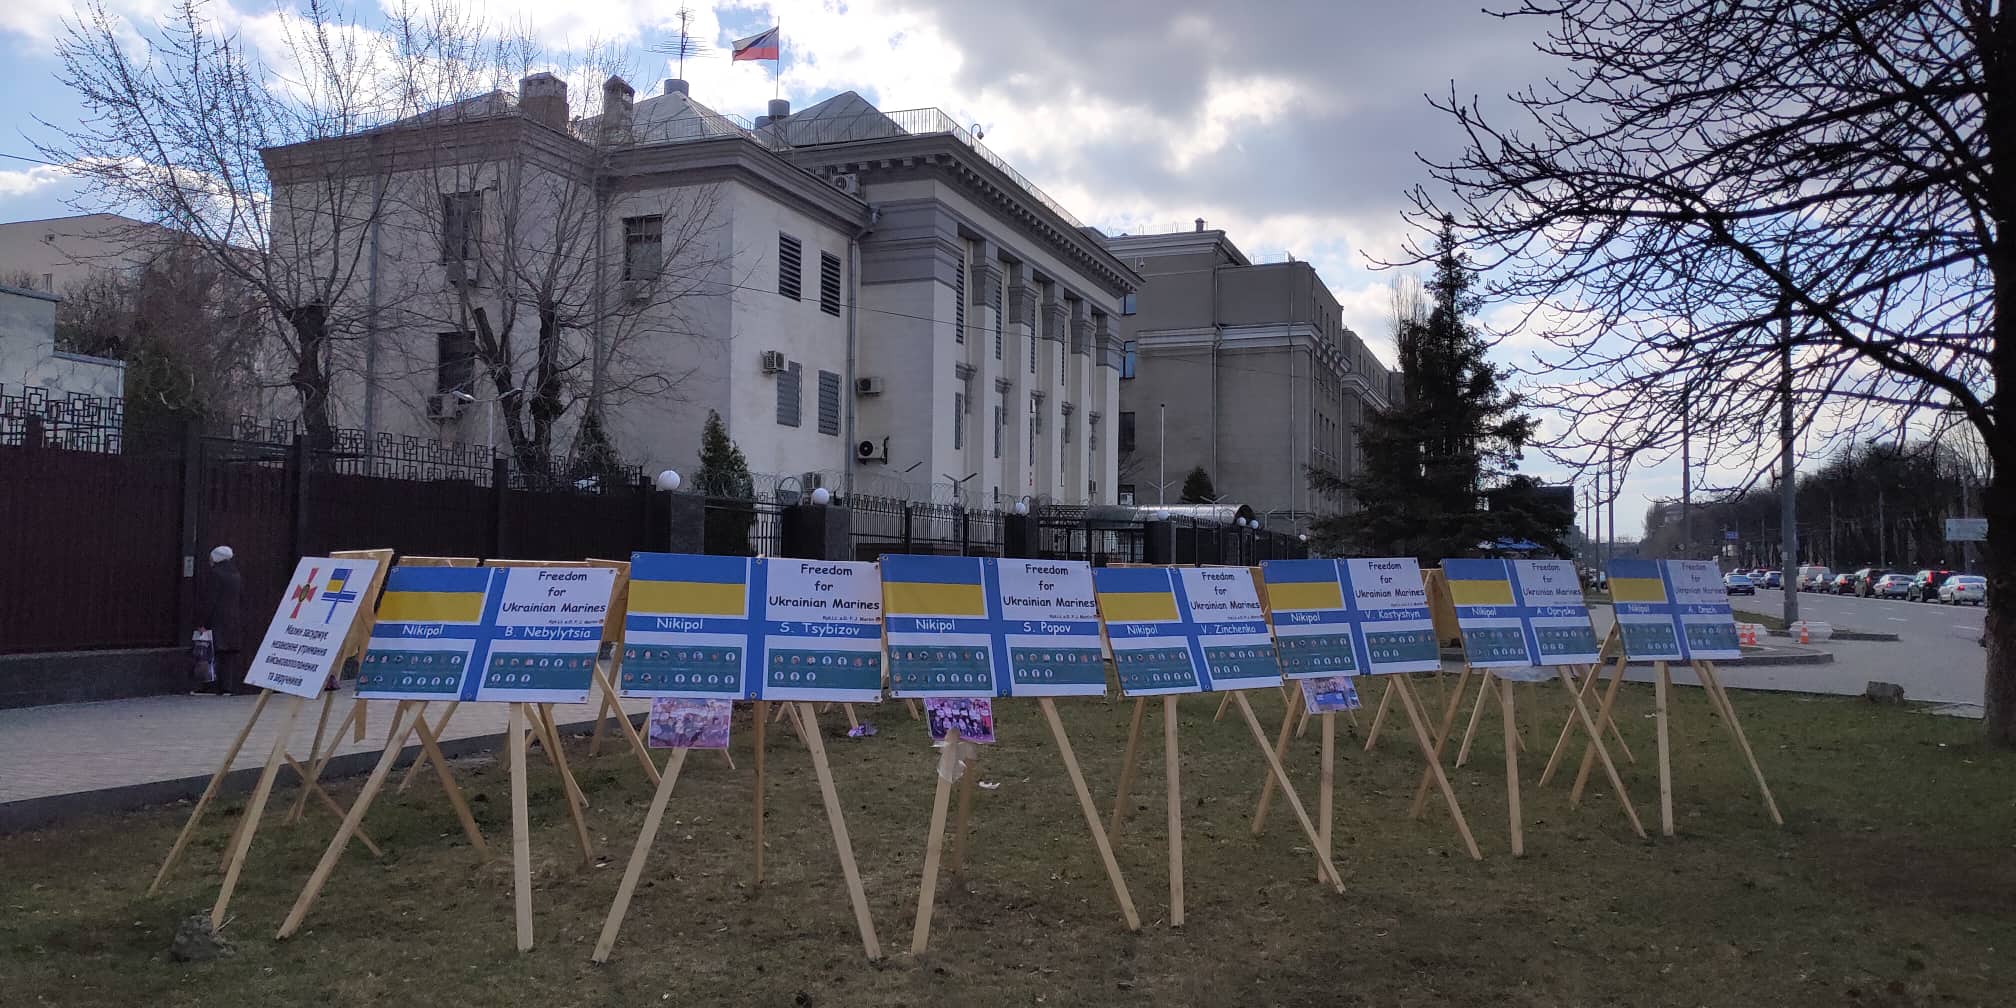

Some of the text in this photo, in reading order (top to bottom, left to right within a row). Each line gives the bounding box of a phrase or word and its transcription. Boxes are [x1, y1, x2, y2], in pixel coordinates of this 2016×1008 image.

[800, 563, 853, 576] Freedom
[1025, 563, 1069, 576] Freedom
[1368, 561, 1403, 571] Freedom
[538, 571, 587, 581] Freedom
[1201, 571, 1236, 581] Freedom
[1380, 575, 1393, 584] for
[814, 580, 834, 591] for
[1038, 580, 1055, 591] for
[1214, 586, 1228, 596] for
[548, 587, 566, 597] for
[1355, 588, 1425, 598] Ukrainian Marines
[769, 596, 880, 610] Ukrainian Marines
[1003, 595, 1095, 608] Ukrainian Marines
[1191, 600, 1261, 611] Ukrainian Marines
[502, 603, 606, 613] Ukrainian Marines
[1291, 612, 1321, 624] Nikipol
[402, 624, 444, 638] Nikipol
[656, 618, 704, 632] Nikipol
[780, 622, 860, 637] S. Tsybizov
[916, 619, 956, 633] Nikipol
[1023, 622, 1071, 635] S. Popov
[1126, 624, 1159, 637] Nikipol
[505, 626, 591, 640] B. Nebylytsia
